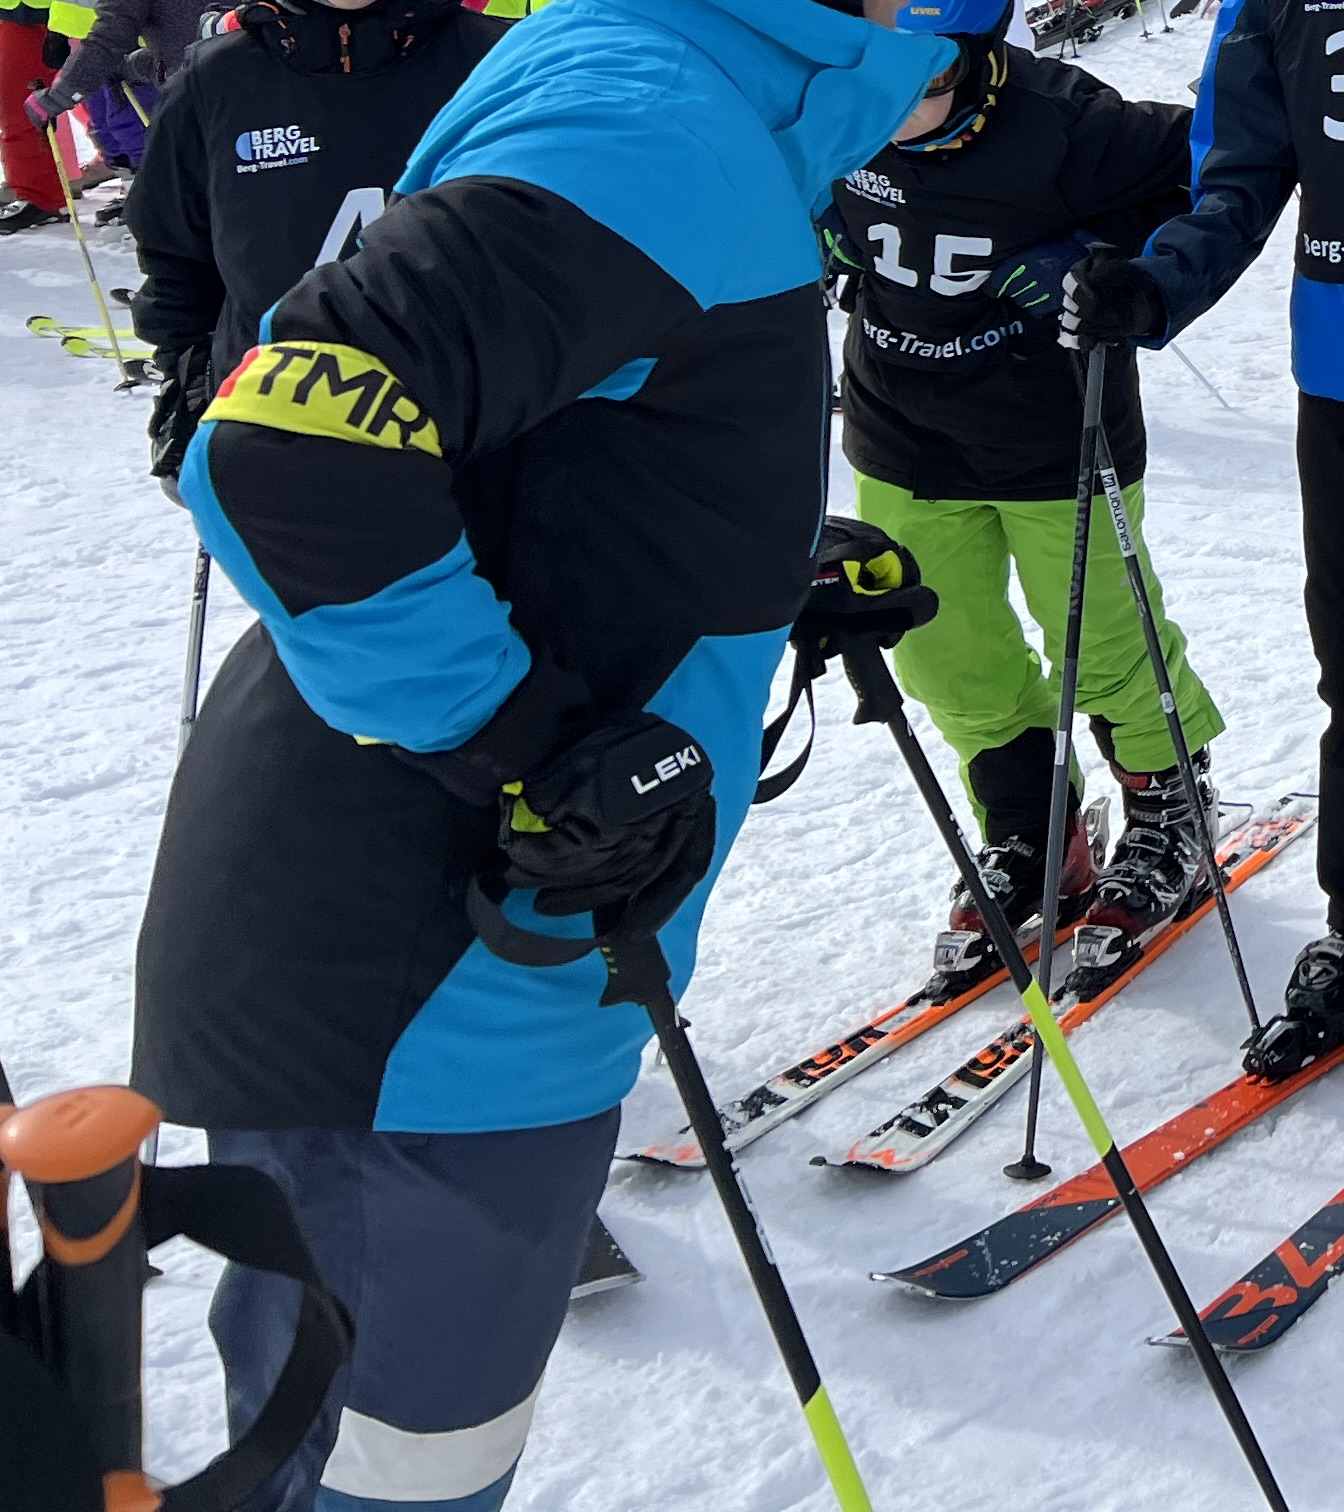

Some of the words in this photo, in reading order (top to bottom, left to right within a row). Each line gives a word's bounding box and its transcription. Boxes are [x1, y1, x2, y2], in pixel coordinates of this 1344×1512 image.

[251, 125, 301, 146] BERG
[252, 137, 320, 161] TRAVEL
[867, 222, 993, 297] 15
[258, 346, 431, 450] TMR
[630, 744, 701, 796] LEKI
